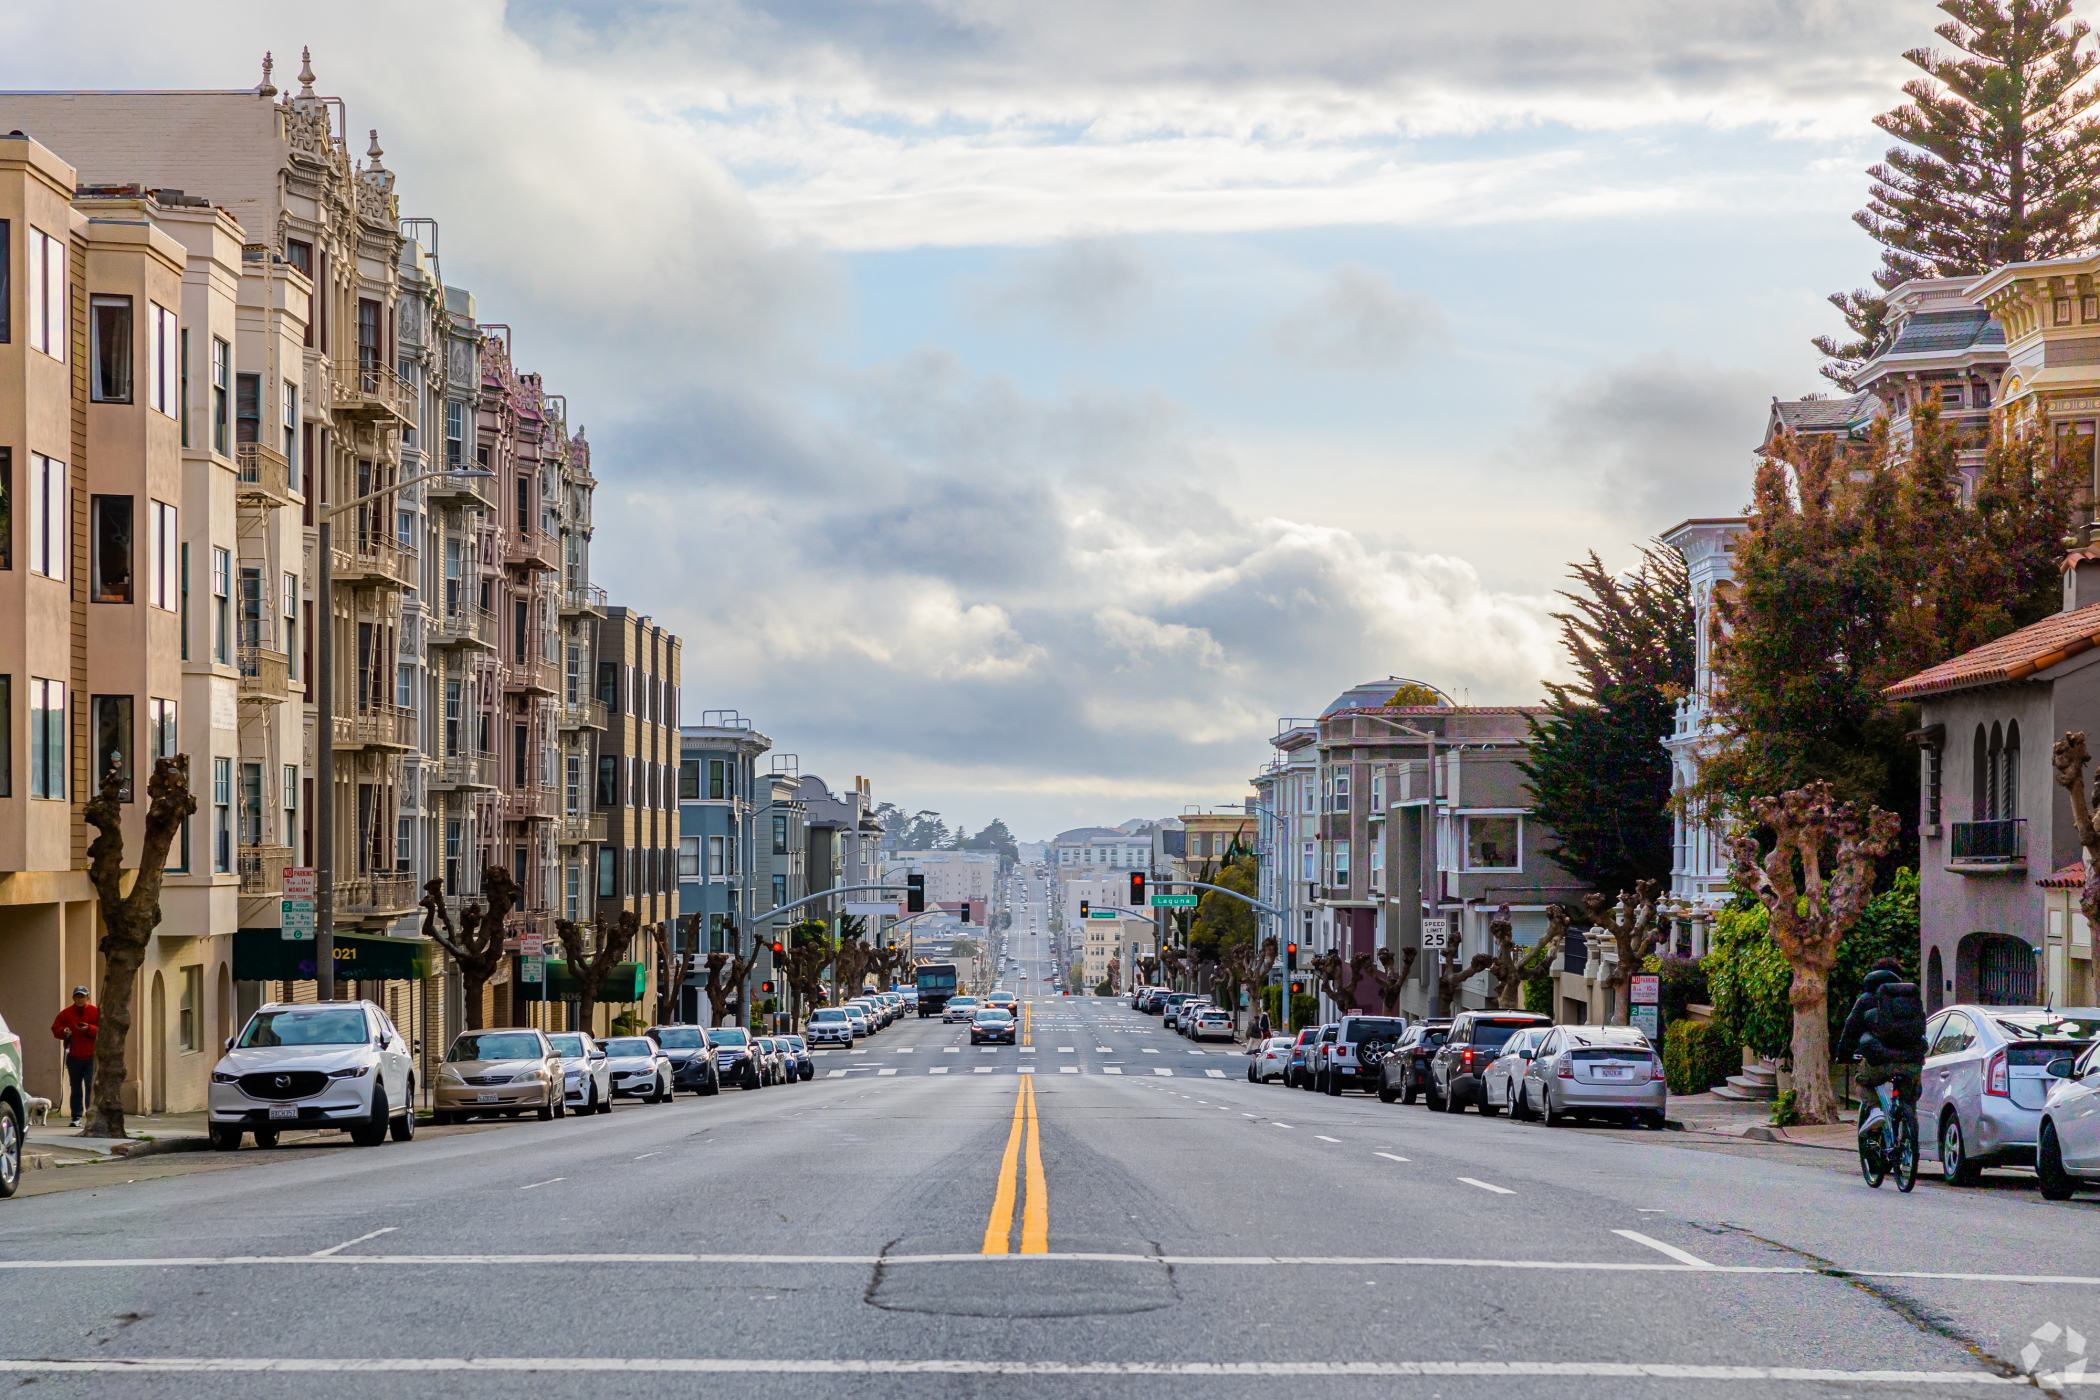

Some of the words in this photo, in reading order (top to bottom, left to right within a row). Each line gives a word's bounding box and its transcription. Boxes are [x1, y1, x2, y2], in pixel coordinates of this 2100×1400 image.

[284, 869, 293, 877] NO
[284, 902, 291, 911] 2
[1424, 934, 1445, 946] 25
[332, 948, 357, 960] 021
[1631, 976, 1640, 984] NO
[560, 992, 582, 1001] 206
[1631, 1007, 1638, 1015] 2
